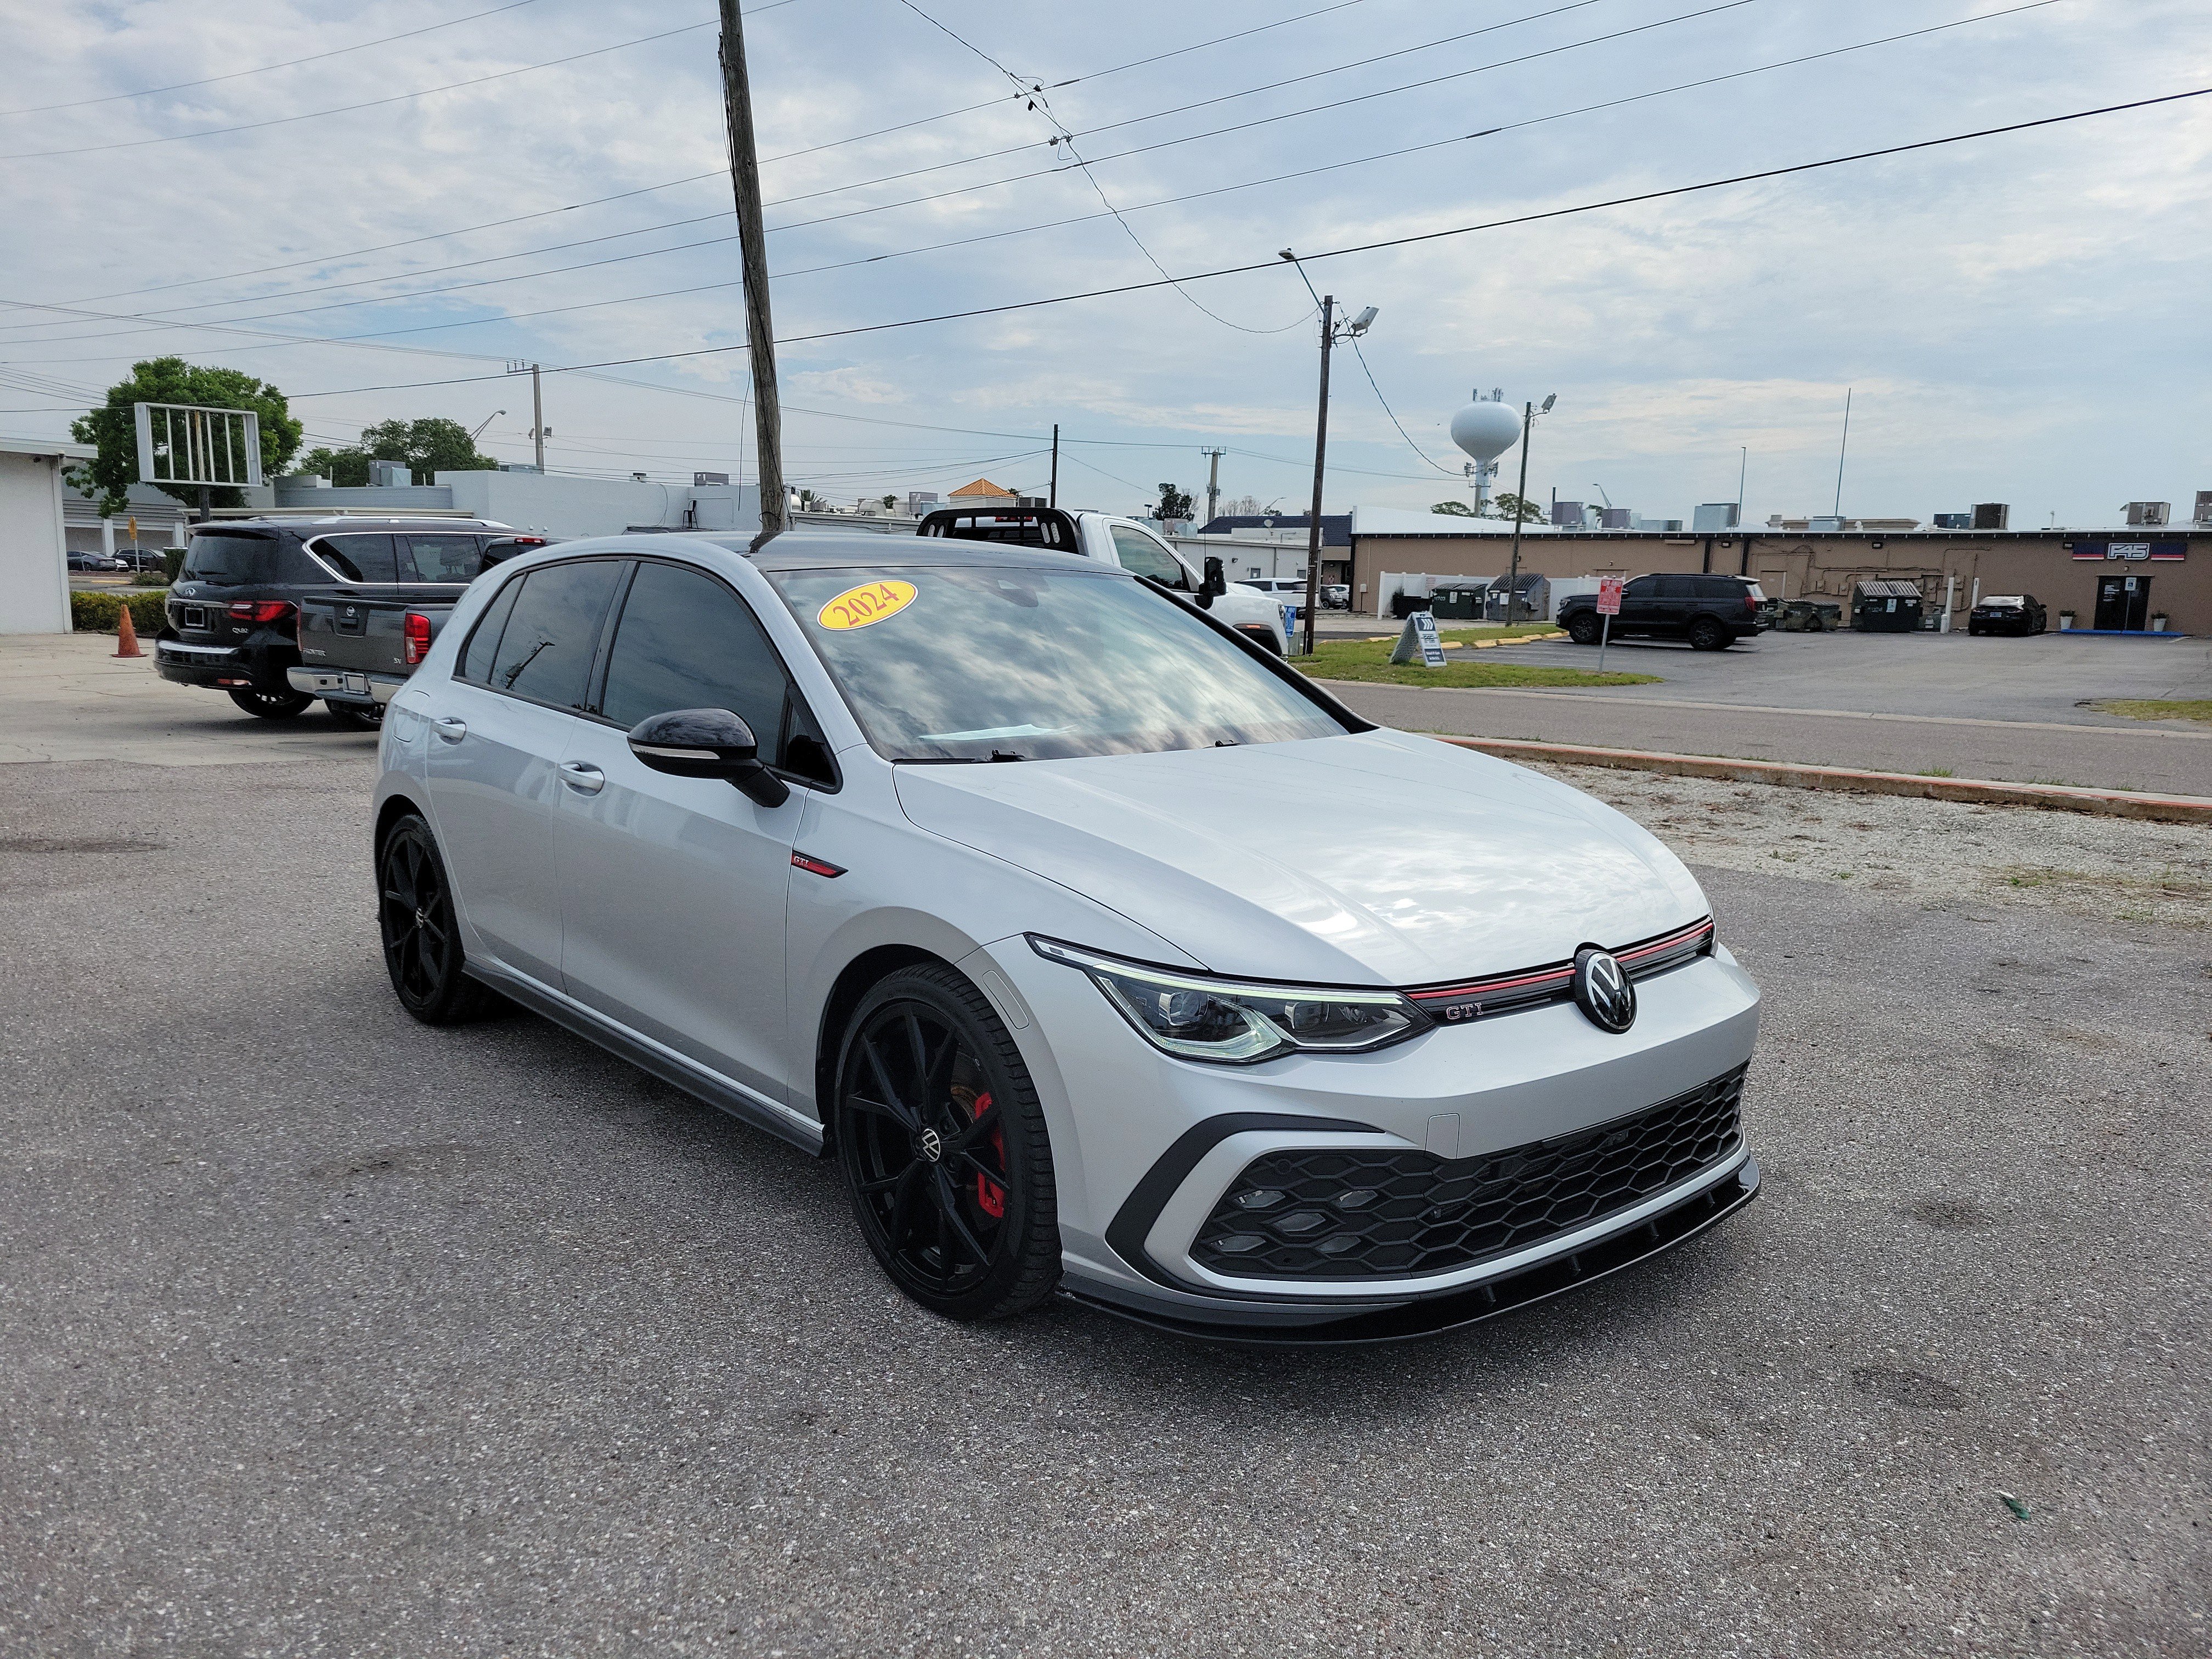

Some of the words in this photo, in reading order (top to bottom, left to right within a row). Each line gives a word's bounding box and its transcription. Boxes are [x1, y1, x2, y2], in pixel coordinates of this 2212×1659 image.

[2107, 543, 2150, 560] F45
[833, 584, 900, 626] 2024
[794, 856, 809, 867] GTI
[1446, 1002, 1483, 1020] GTI
